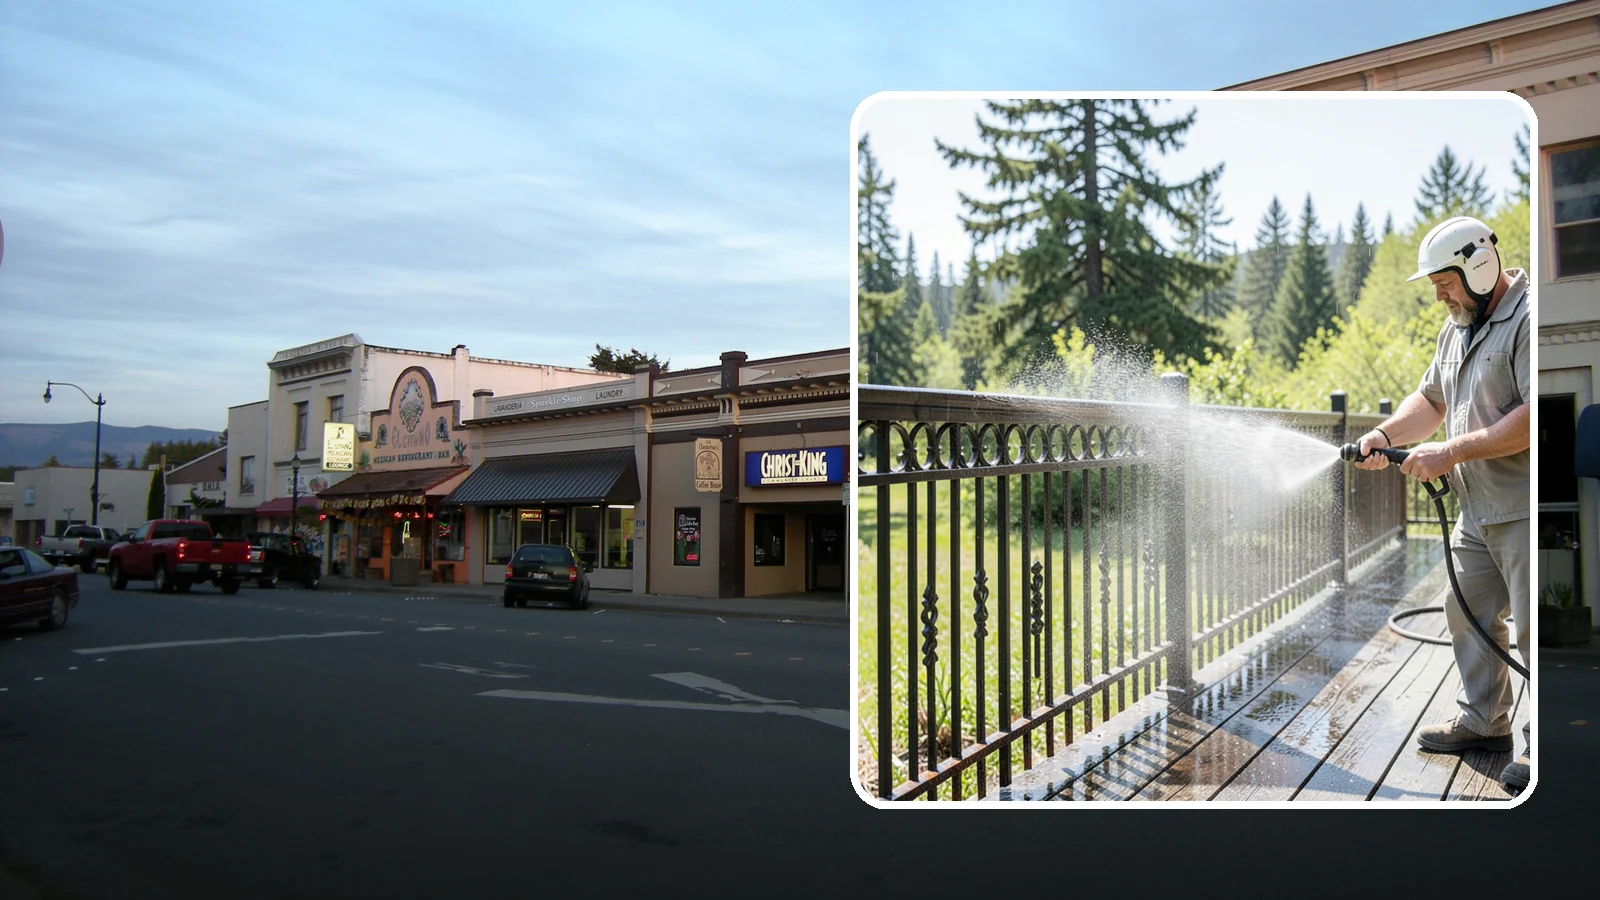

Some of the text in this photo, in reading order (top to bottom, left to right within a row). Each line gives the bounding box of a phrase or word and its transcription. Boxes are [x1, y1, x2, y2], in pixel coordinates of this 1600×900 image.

[494, 389, 623, 412] LAVANDERIA Sparkle Shop LAUNDRY
[374, 454, 396, 464] MEXICAN
[398, 451, 432, 462] RESTAURANT
[438, 450, 450, 458] BAR
[760, 450, 827, 478] CHRIST KING
